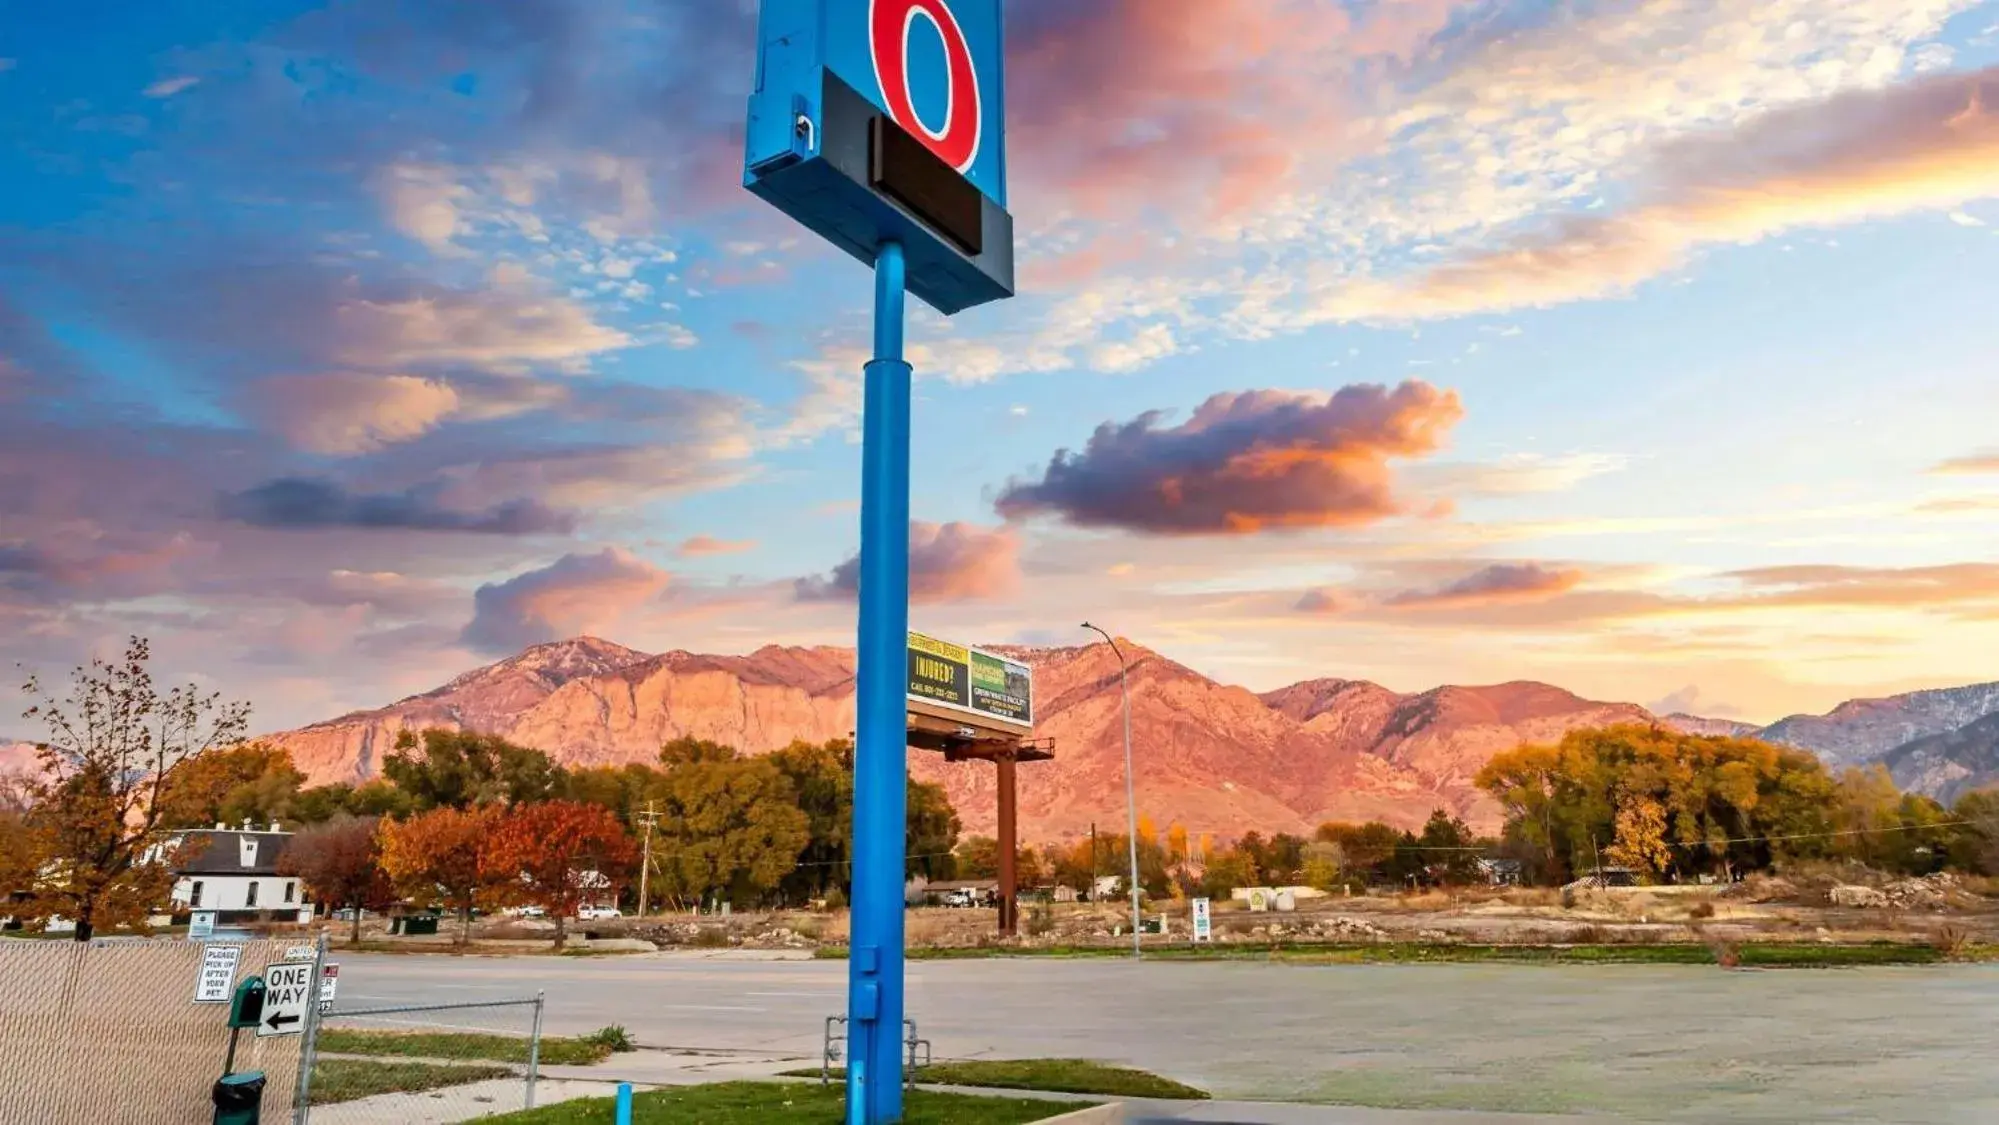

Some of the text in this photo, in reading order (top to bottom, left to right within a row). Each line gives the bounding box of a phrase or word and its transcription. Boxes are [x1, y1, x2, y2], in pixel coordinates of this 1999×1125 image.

[208, 951, 235, 959] PLEASE
[206, 960, 222, 968] PICK
[271, 968, 307, 986] ONE
[267, 987, 305, 1006] WAY
